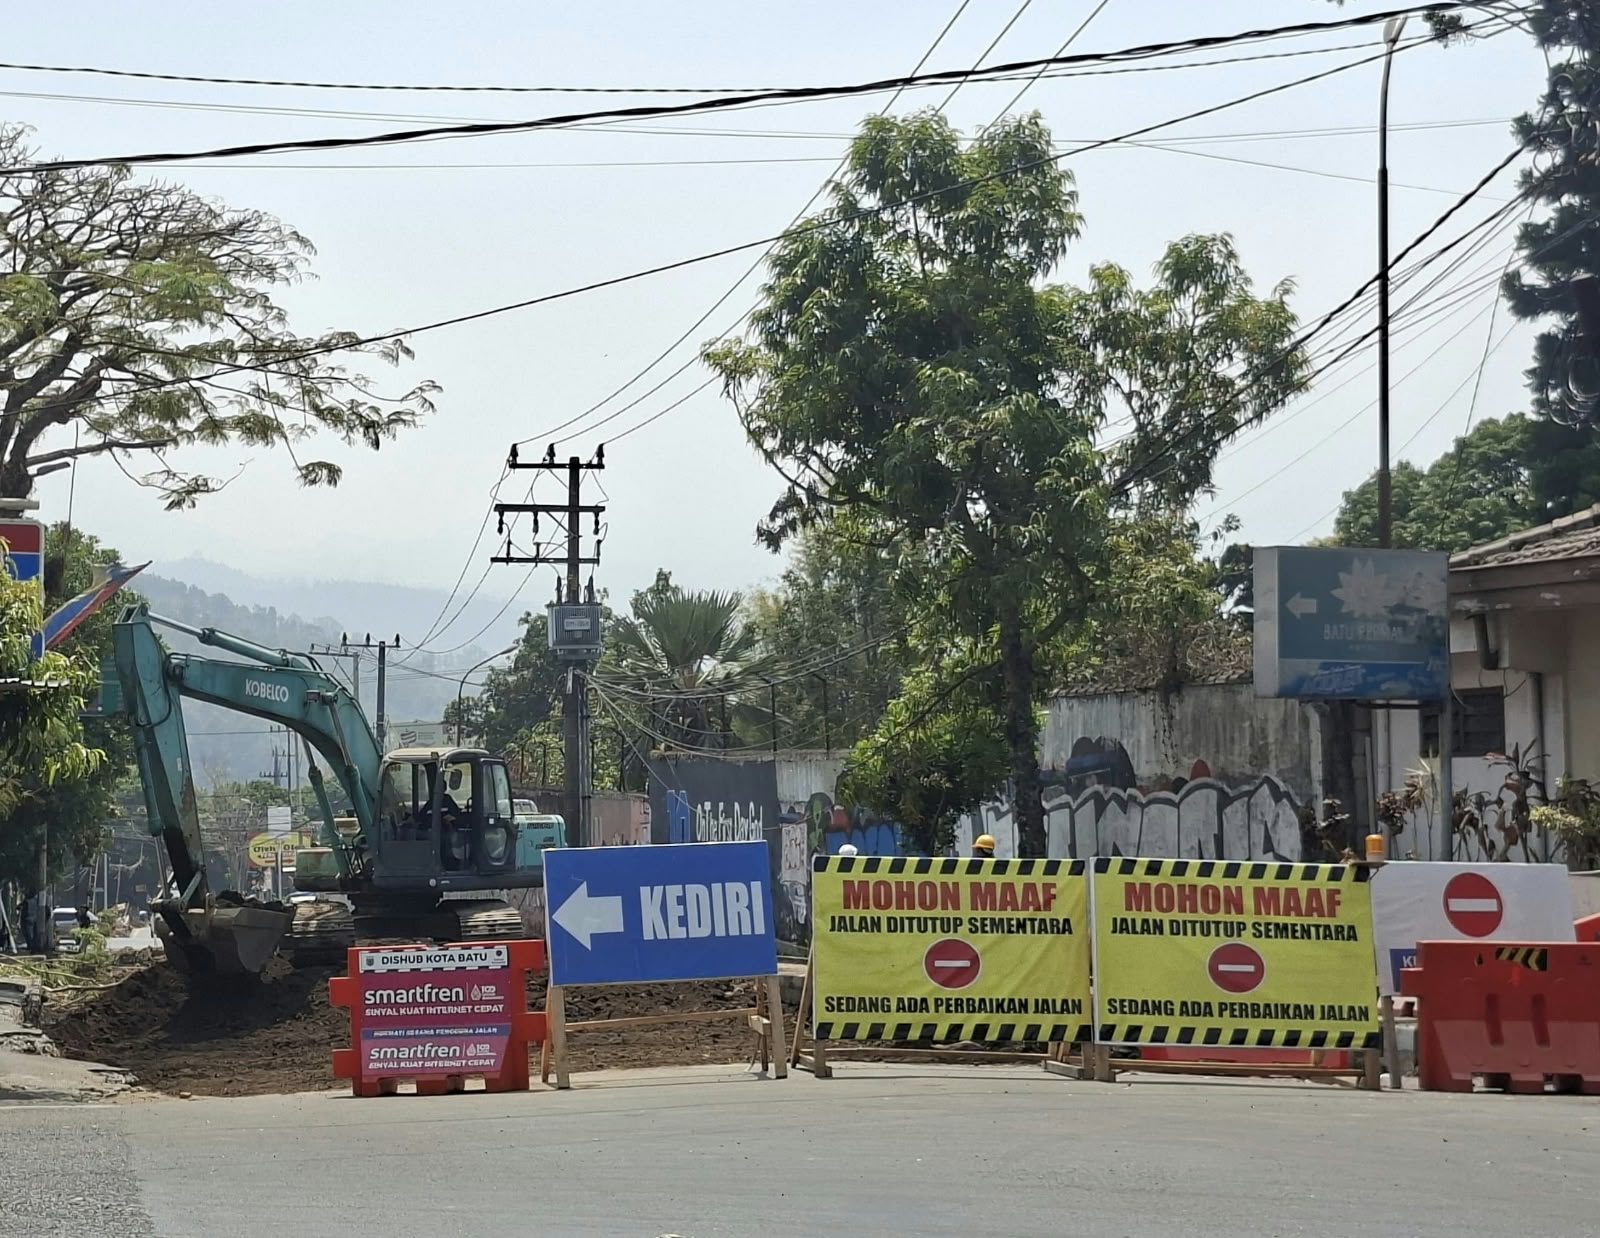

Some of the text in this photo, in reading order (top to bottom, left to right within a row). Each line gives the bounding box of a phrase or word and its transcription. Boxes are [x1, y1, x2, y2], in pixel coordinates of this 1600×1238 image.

[245, 678, 289, 702] KOBELCO
[843, 879, 1057, 912] MOHON MAAF
[1124, 882, 1342, 918] MOHON MAAF
[640, 880, 766, 940] KEDIRI
[829, 915, 1073, 935] JALAN DITUTUP SEMENTARA
[1111, 917, 1359, 942] JALAN DITUTUP SEMENTARA
[381, 954, 423, 965] DISHUB
[426, 953, 456, 964] KOTA
[458, 953, 488, 963] BATU
[365, 984, 463, 1003] smartfren
[365, 1004, 505, 1016] SINYAL KUAT INTERNET CEPAT
[824, 996, 1082, 1015] SEDANG ADA PERBAIKAN JALAN
[1107, 998, 1370, 1022] SEDANG ADA PERBAIKAN JALAN
[370, 1043, 459, 1059] smartfren
[368, 1061, 400, 1069] SINYAL
[400, 1060, 423, 1068] KUAT
[468, 1059, 496, 1067] CEPAT
